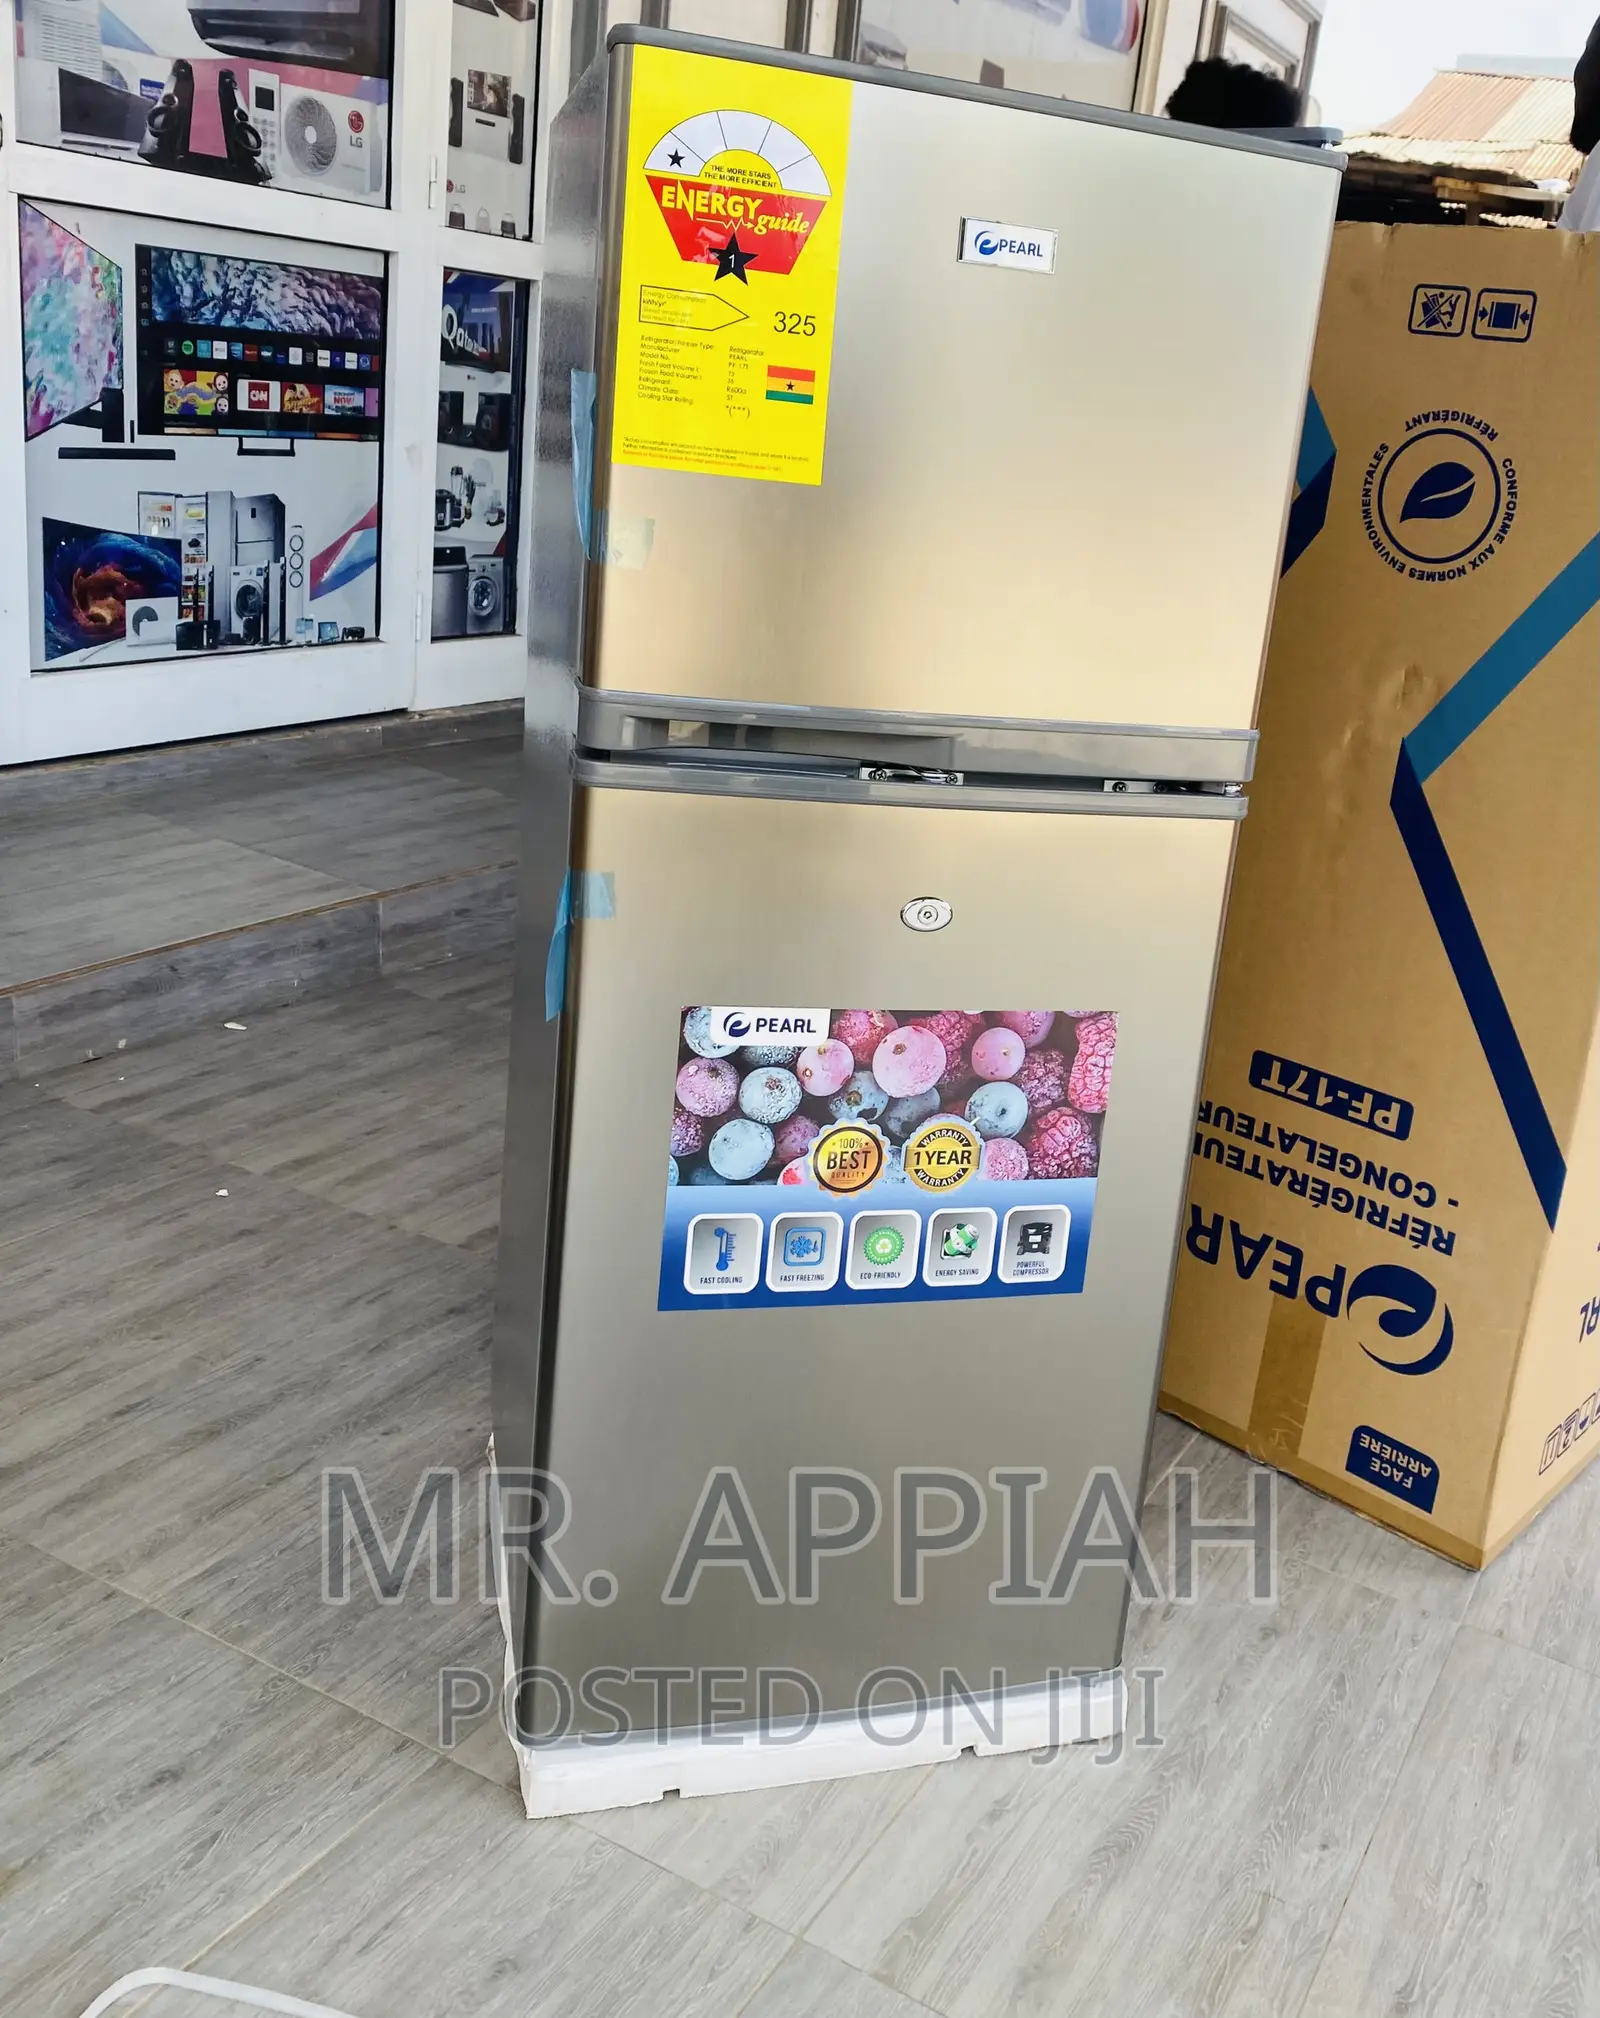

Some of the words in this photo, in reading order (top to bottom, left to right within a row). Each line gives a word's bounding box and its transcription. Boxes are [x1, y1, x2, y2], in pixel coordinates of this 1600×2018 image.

[349, 135, 363, 148] LG
[704, 172, 718, 180] THE
[719, 174, 740, 184] MORE
[742, 177, 777, 189] EFFICIENT
[711, 165, 725, 173] THE
[727, 168, 747, 176] MORE
[749, 170, 771, 180] STARS
[661, 180, 763, 221] ENERGY
[753, 212, 810, 236] guide
[999, 238, 1043, 257] PEARL
[728, 254, 736, 269] 1
[773, 311, 816, 337] 325
[728, 353, 748, 362] PEARL
[249, 390, 268, 402] CNN
[1404, 409, 1499, 442] RÉFRIGÉRANT
[1361, 442, 1407, 574] ENVIRONMENTALES
[1493, 457, 1518, 544] CONFORME
[1468, 543, 1496, 571] AUX
[1408, 565, 1468, 582] NORMES
[755, 1018, 816, 1033] PEARL
[1261, 1060, 1401, 1133] PF-17T
[839, 1137, 864, 1149] 100%
[921, 1128, 969, 1147] WARRANTY
[826, 1151, 872, 1170] BEST
[1197, 1100, 1437, 1209] CONGELATEUR
[831, 1171, 866, 1180] QUALITY
[916, 1169, 966, 1187] WARRANTY
[1016, 1260, 1046, 1268] POWERFUL
[1185, 1203, 1347, 1319] PEAR
[716, 1276, 743, 1284] COOLING
[796, 1273, 825, 1282] FREEZING
[935, 1269, 957, 1277] ENERGY
[958, 1268, 979, 1276] SAVING
[1012, 1268, 1050, 1276] COMPRESSOR
[1359, 1433, 1432, 1478] ARRIÈRE
[1370, 1457, 1413, 1489] FACE
